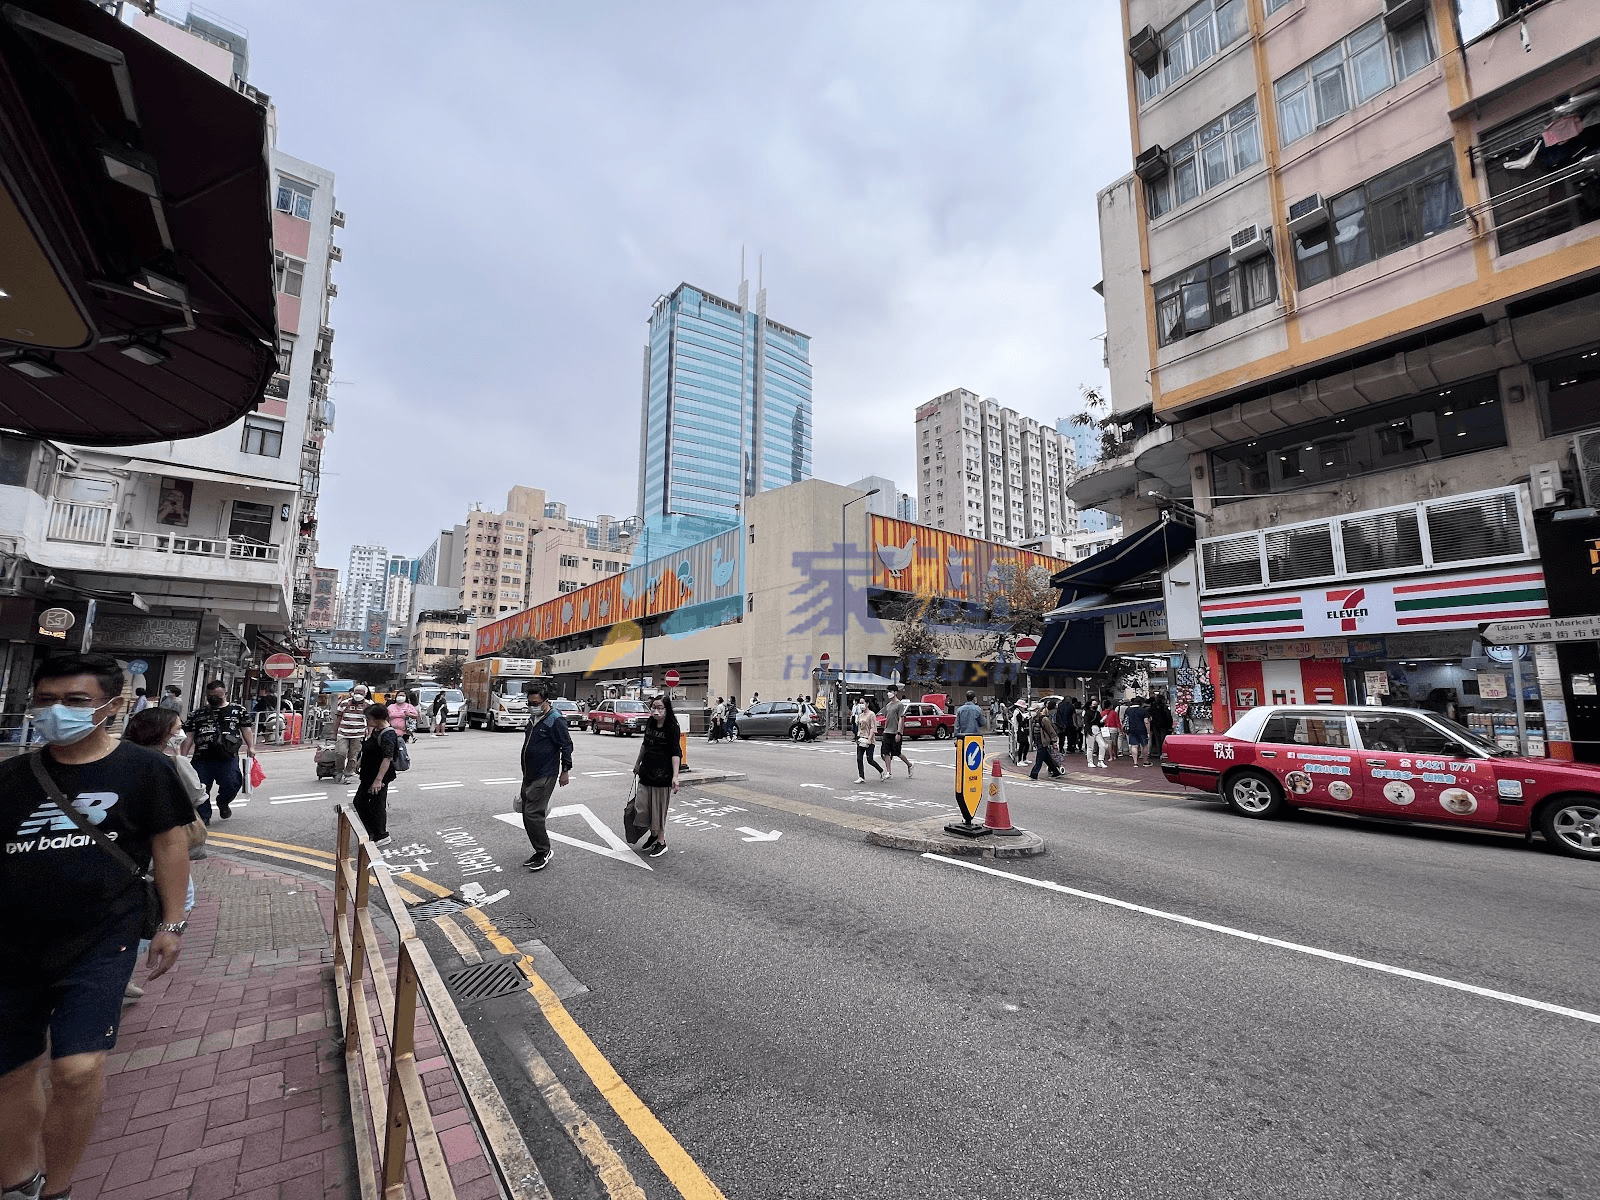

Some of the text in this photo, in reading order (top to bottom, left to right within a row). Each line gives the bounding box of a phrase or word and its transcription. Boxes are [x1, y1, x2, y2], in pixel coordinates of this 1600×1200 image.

[1326, 588, 1365, 631] 7
[1117, 611, 1148, 629] IDEA
[1555, 618, 1594, 627] Market
[172, 659, 187, 687] SAINT
[1213, 742, 1234, 751] 的士
[1214, 749, 1235, 760] TAXI
[1415, 759, 1476, 773] 3421 1771
[436, 826, 503, 877] LOOK RIGHT
